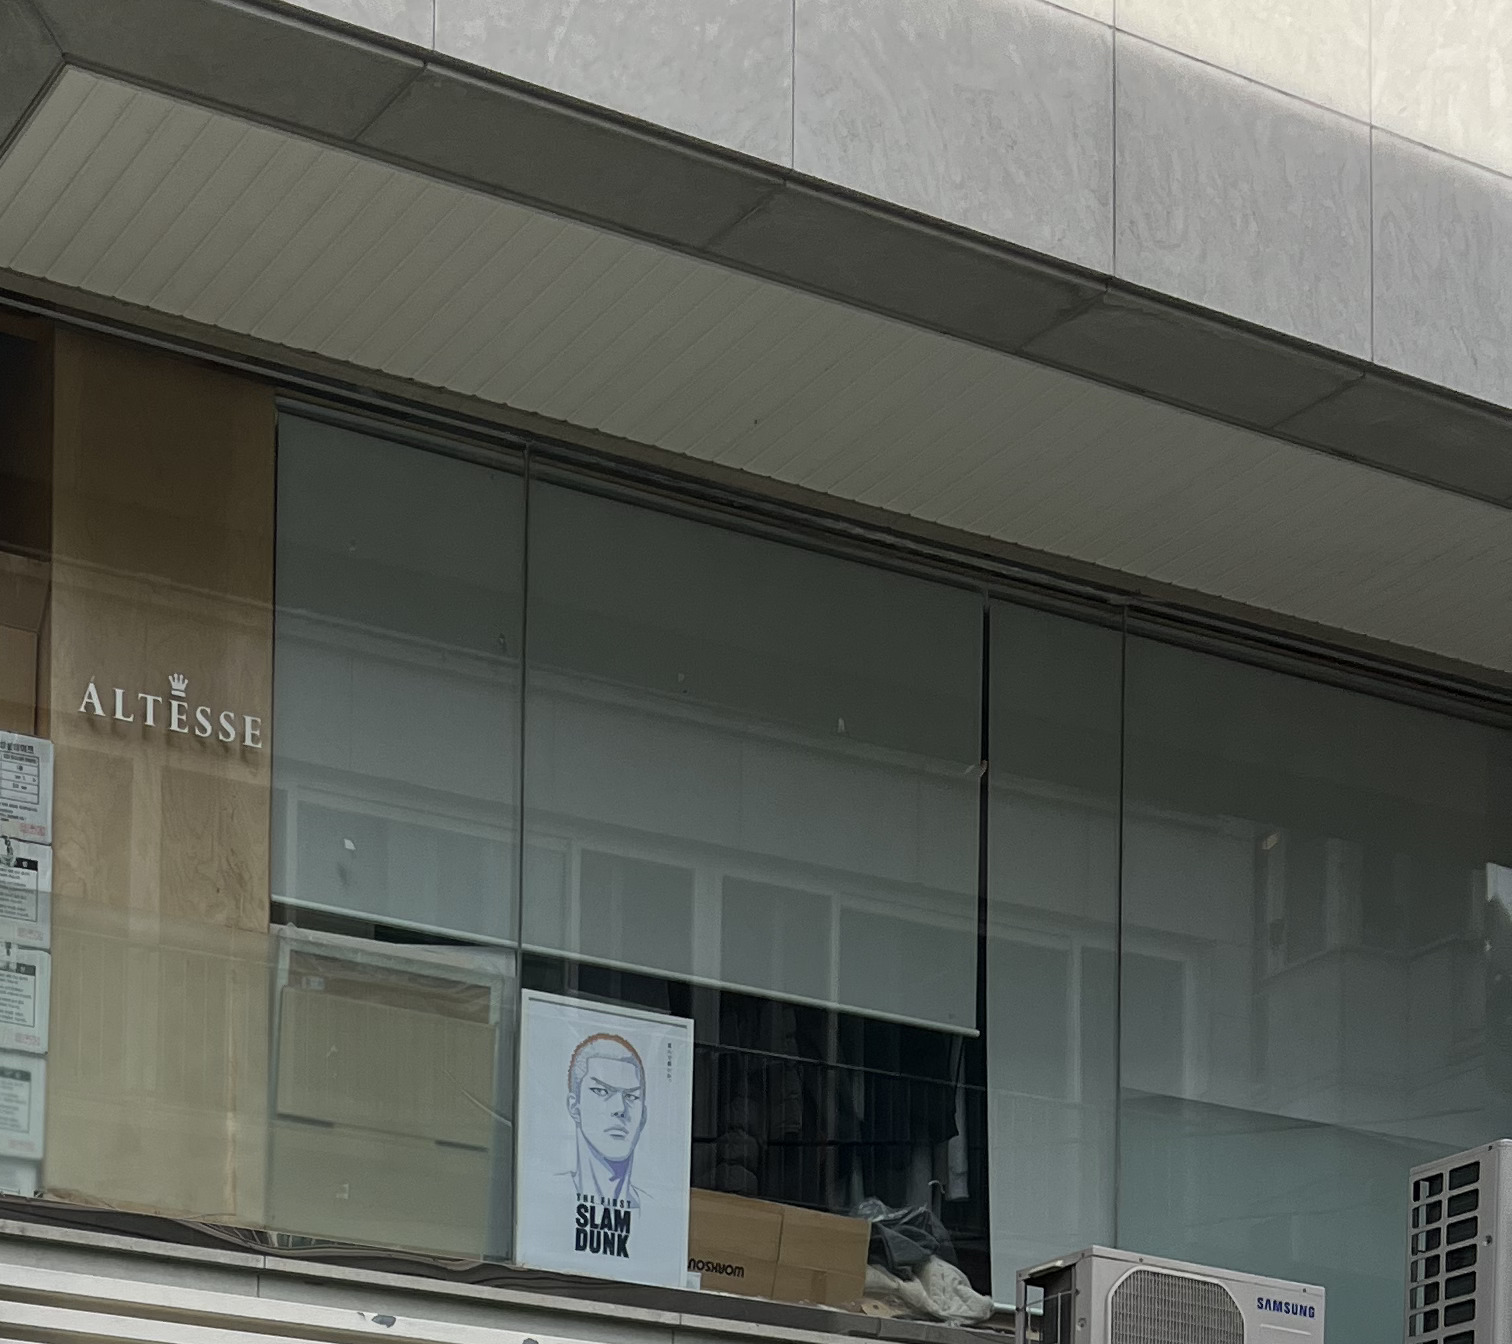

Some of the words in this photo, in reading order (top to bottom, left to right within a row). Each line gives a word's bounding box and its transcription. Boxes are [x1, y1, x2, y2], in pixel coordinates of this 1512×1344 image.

[576, 1193, 595, 1204] THE
[601, 1197, 631, 1209] FIRST
[575, 1203, 631, 1234] SLAM
[575, 1227, 630, 1259] DUNK
[688, 1258, 745, 1278] WORKSOU
[1257, 1297, 1316, 1318] SAMSUNG
